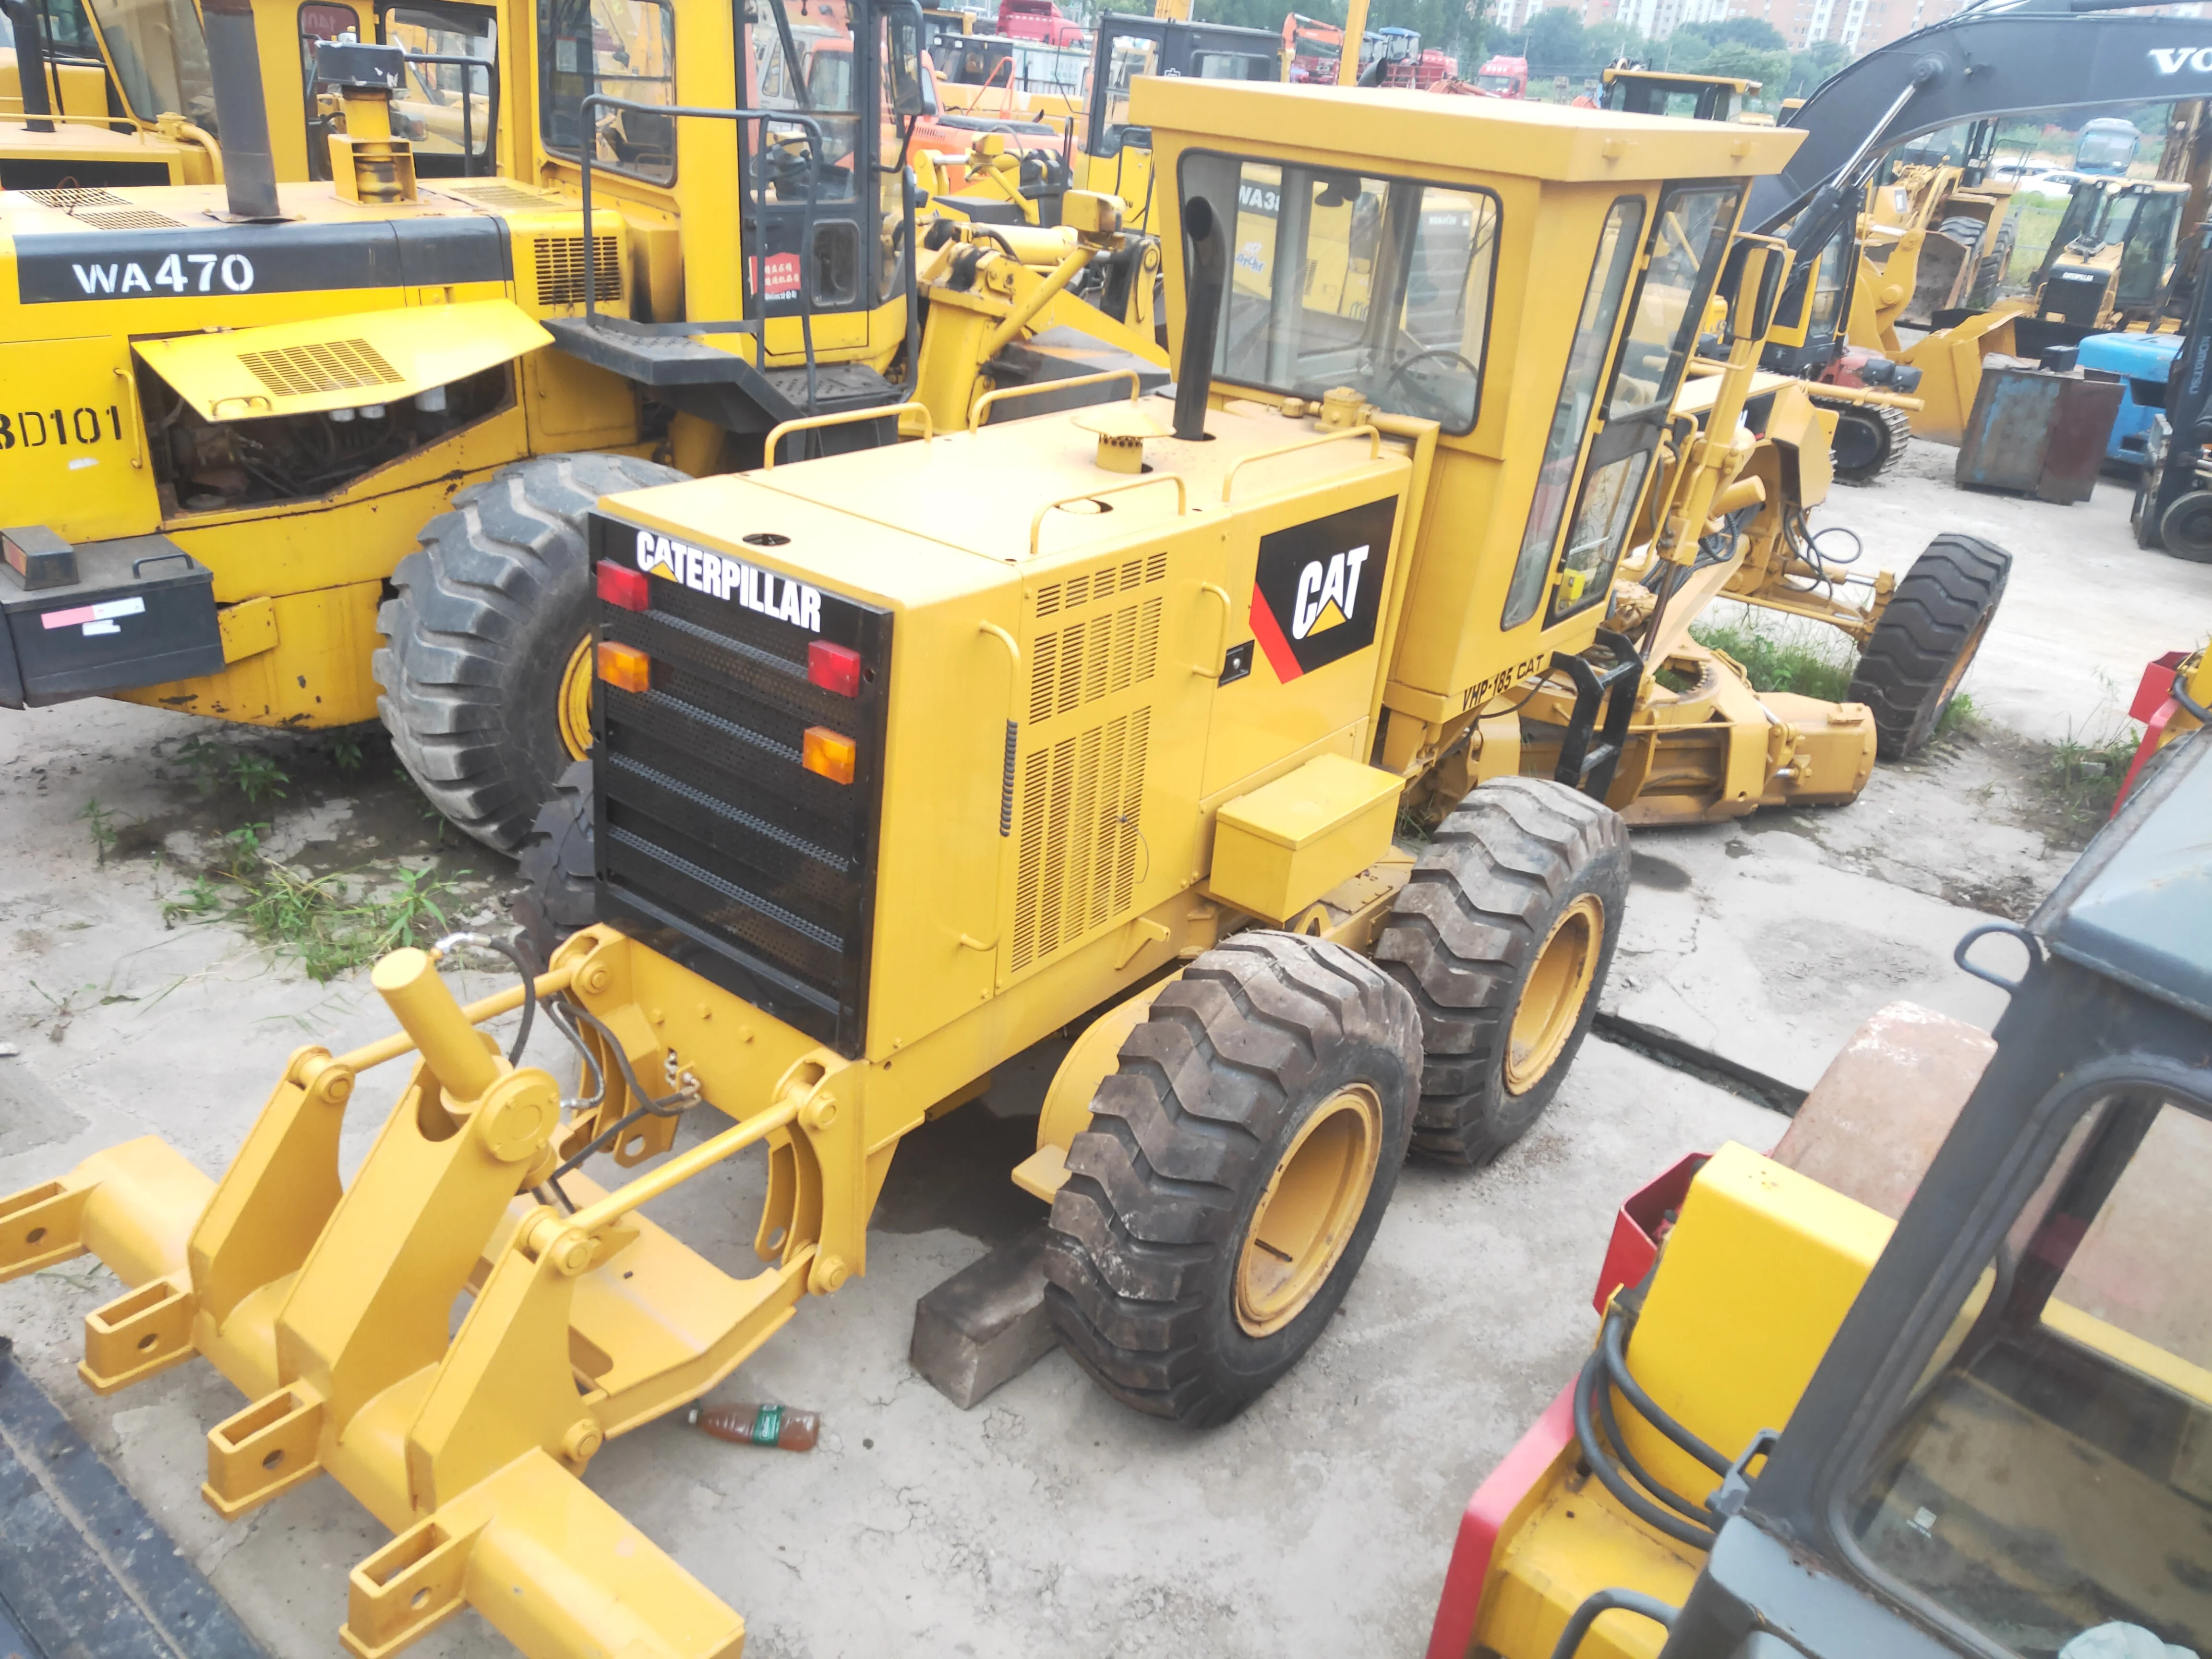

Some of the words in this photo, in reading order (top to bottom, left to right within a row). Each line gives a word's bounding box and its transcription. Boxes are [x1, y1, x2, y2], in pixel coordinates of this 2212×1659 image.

[72, 253, 254, 294] WA470
[637, 530, 821, 633] CATERPILLAR
[1292, 544, 1370, 639] CAT
[1462, 667, 1513, 712] VHP-185
[1517, 654, 1544, 680] CAT
